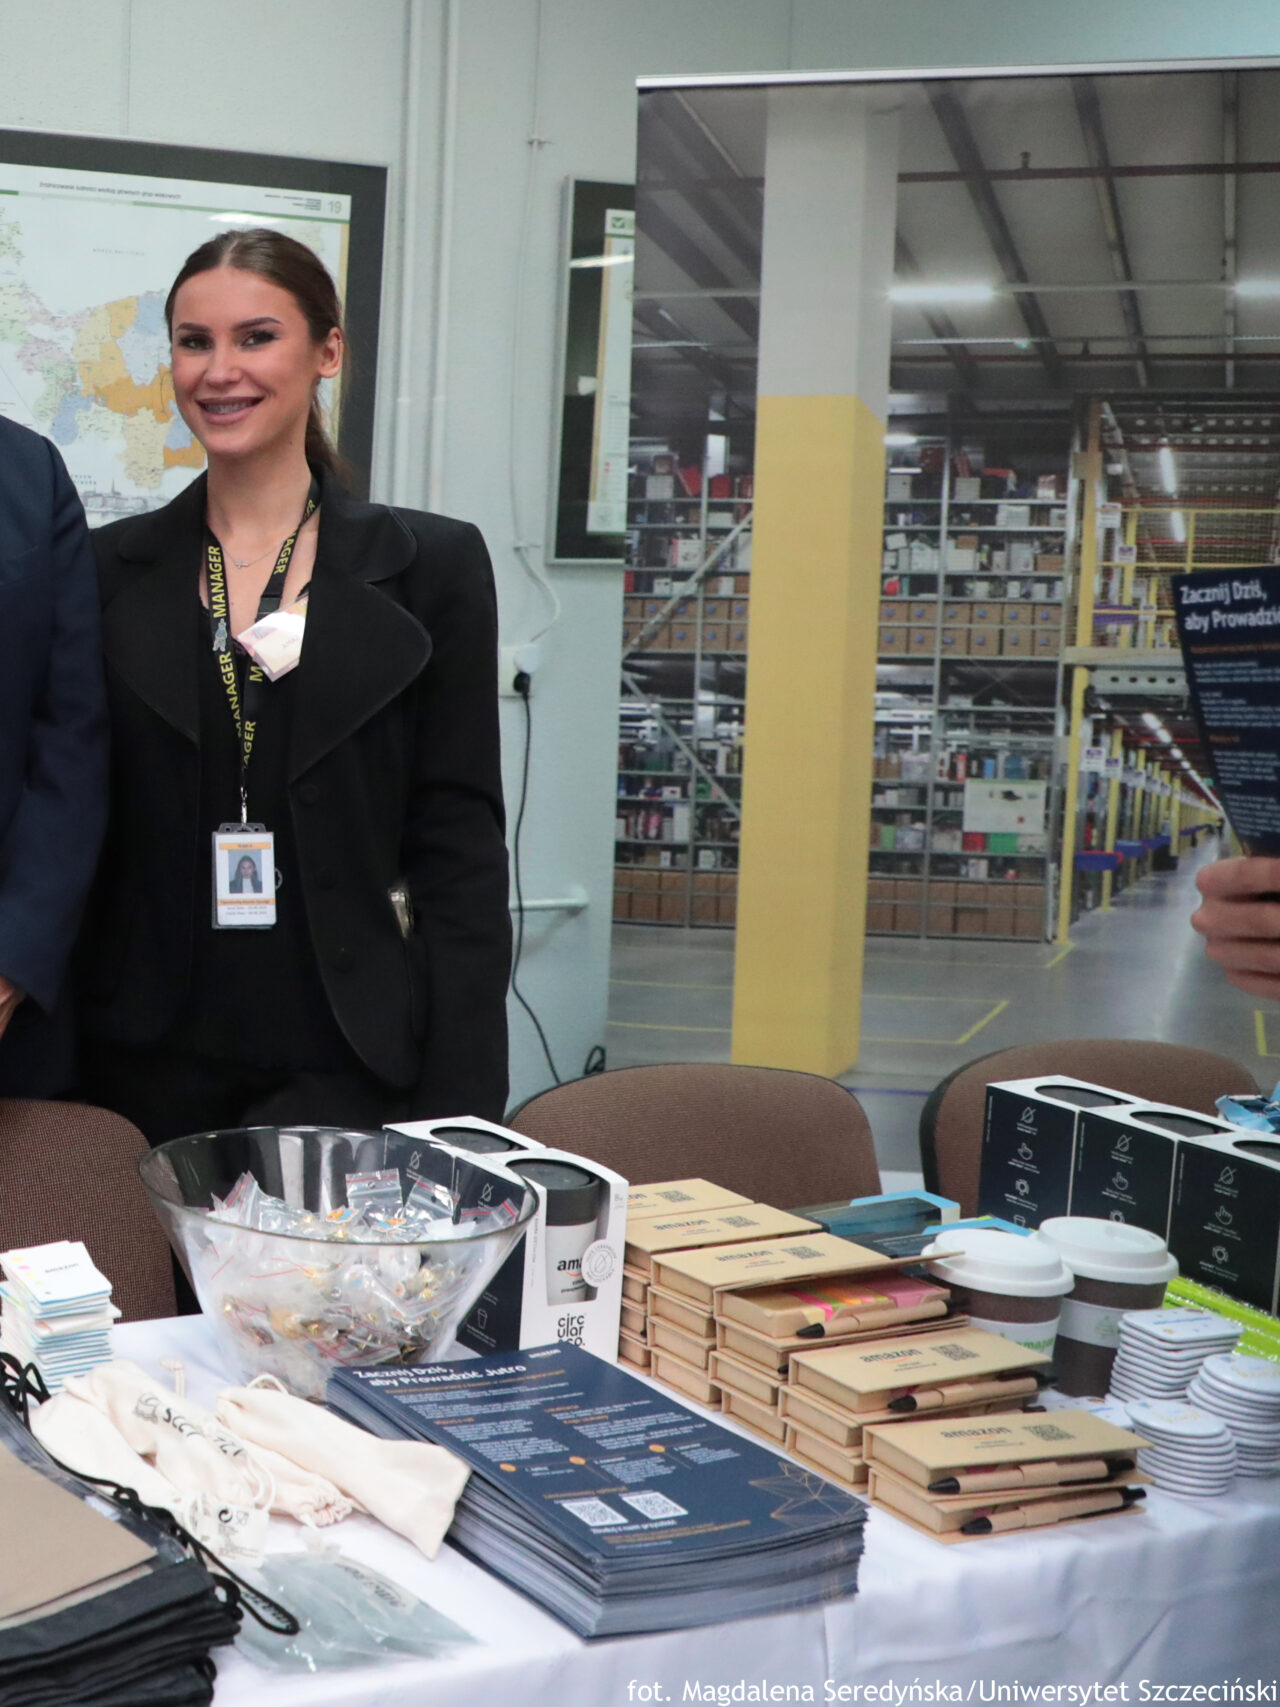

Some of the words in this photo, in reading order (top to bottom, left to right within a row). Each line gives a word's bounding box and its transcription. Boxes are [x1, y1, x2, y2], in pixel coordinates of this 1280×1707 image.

[327, 200, 342, 214] 19
[208, 545, 227, 618] MANAGER
[1179, 583, 1231, 606] Zacznij
[1184, 611, 1209, 634] aby
[219, 651, 244, 738] MANAGER
[653, 1219, 710, 1231] amazon
[714, 1249, 775, 1263] amazon
[858, 1348, 923, 1364] amazon
[352, 1368, 414, 1379] Zacznij
[369, 1378, 399, 1388] aby
[485, 1364, 527, 1377] Jutro
[939, 1425, 1012, 1440] amazon
